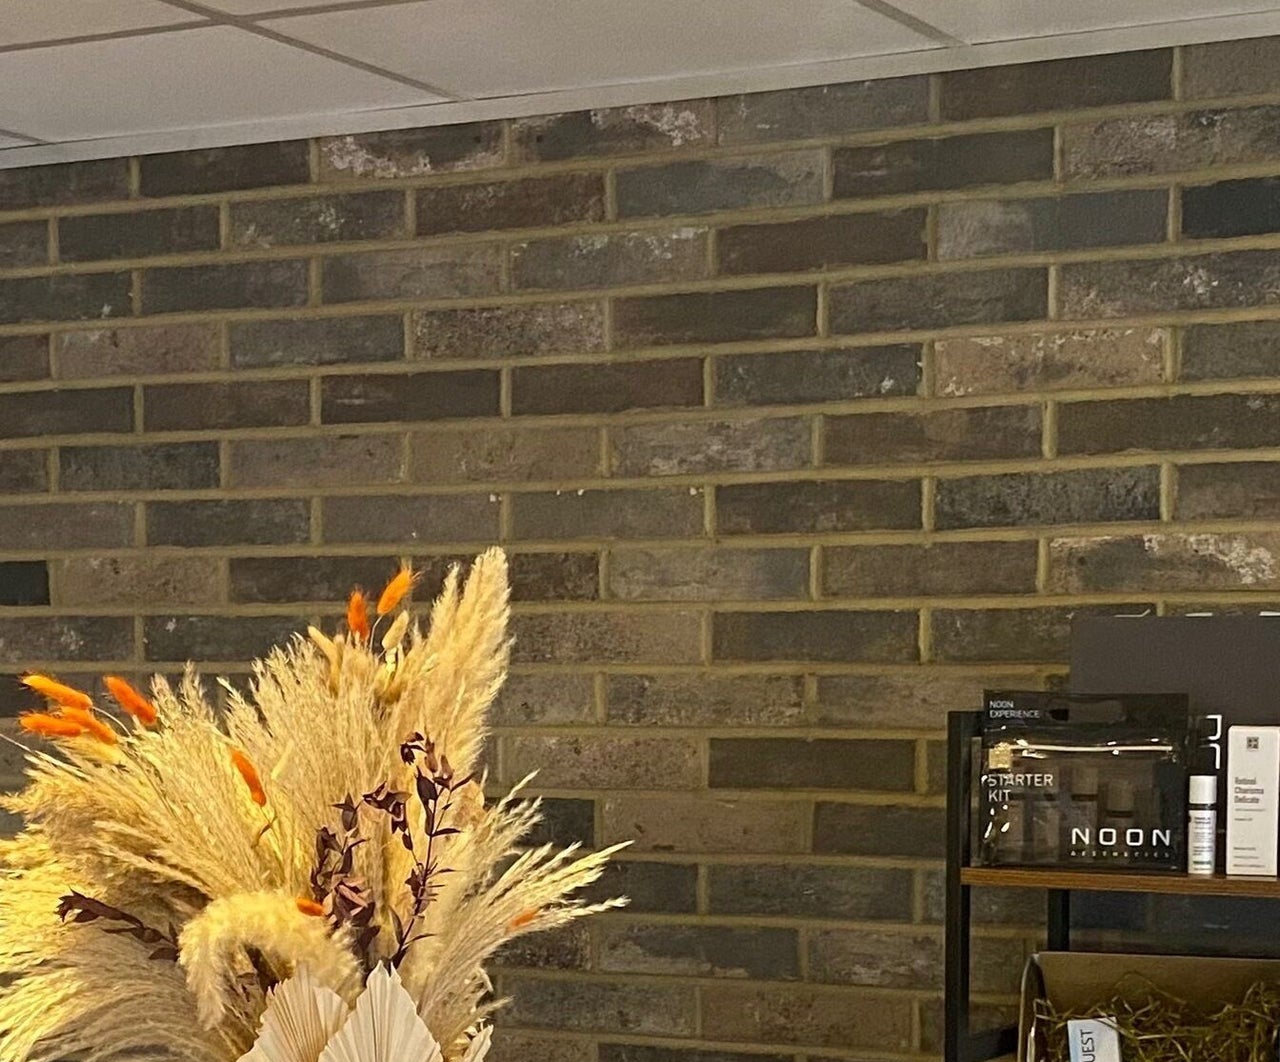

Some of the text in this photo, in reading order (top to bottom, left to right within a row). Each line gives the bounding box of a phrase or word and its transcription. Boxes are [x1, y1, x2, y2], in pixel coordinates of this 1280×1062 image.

[988, 773, 1054, 787] STARTER
[988, 789, 1011, 802] KIT
[1071, 827, 1171, 846] NOON
